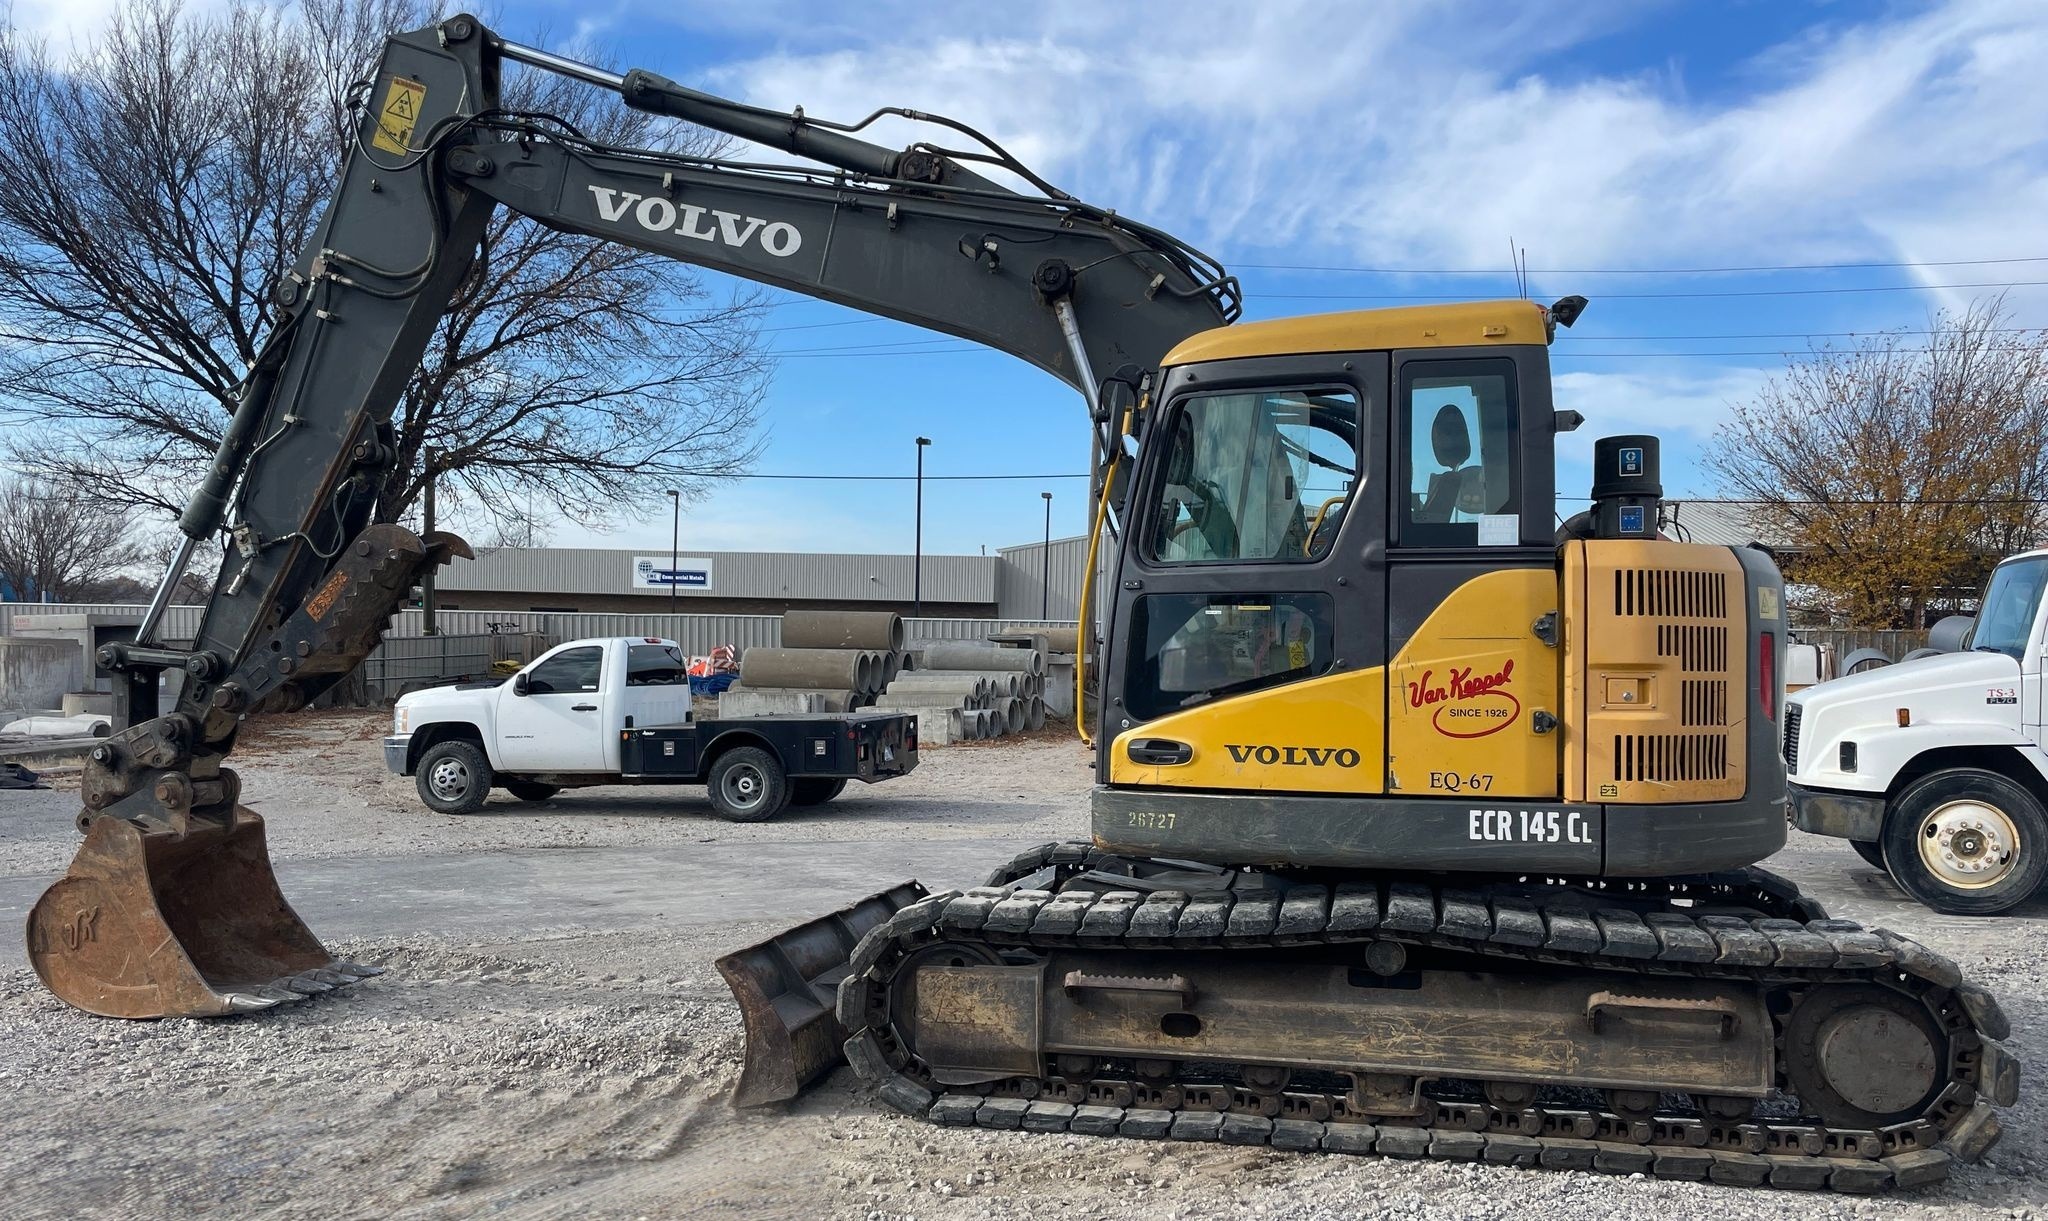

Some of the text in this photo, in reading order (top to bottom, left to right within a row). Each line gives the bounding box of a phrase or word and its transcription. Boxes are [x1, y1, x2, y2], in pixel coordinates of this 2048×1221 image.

[588, 185, 802, 257] VOLVO
[1409, 659, 1514, 707] Van Keppel
[1987, 688, 2015, 697] TS-3
[1449, 708, 1508, 717] SINCE 1926
[1224, 744, 1361, 768] VOLVO
[1429, 772, 1493, 792] EQ-67
[1128, 811, 1176, 830] 26727
[1469, 810, 1512, 840] ECR
[1520, 811, 1560, 842] 145
